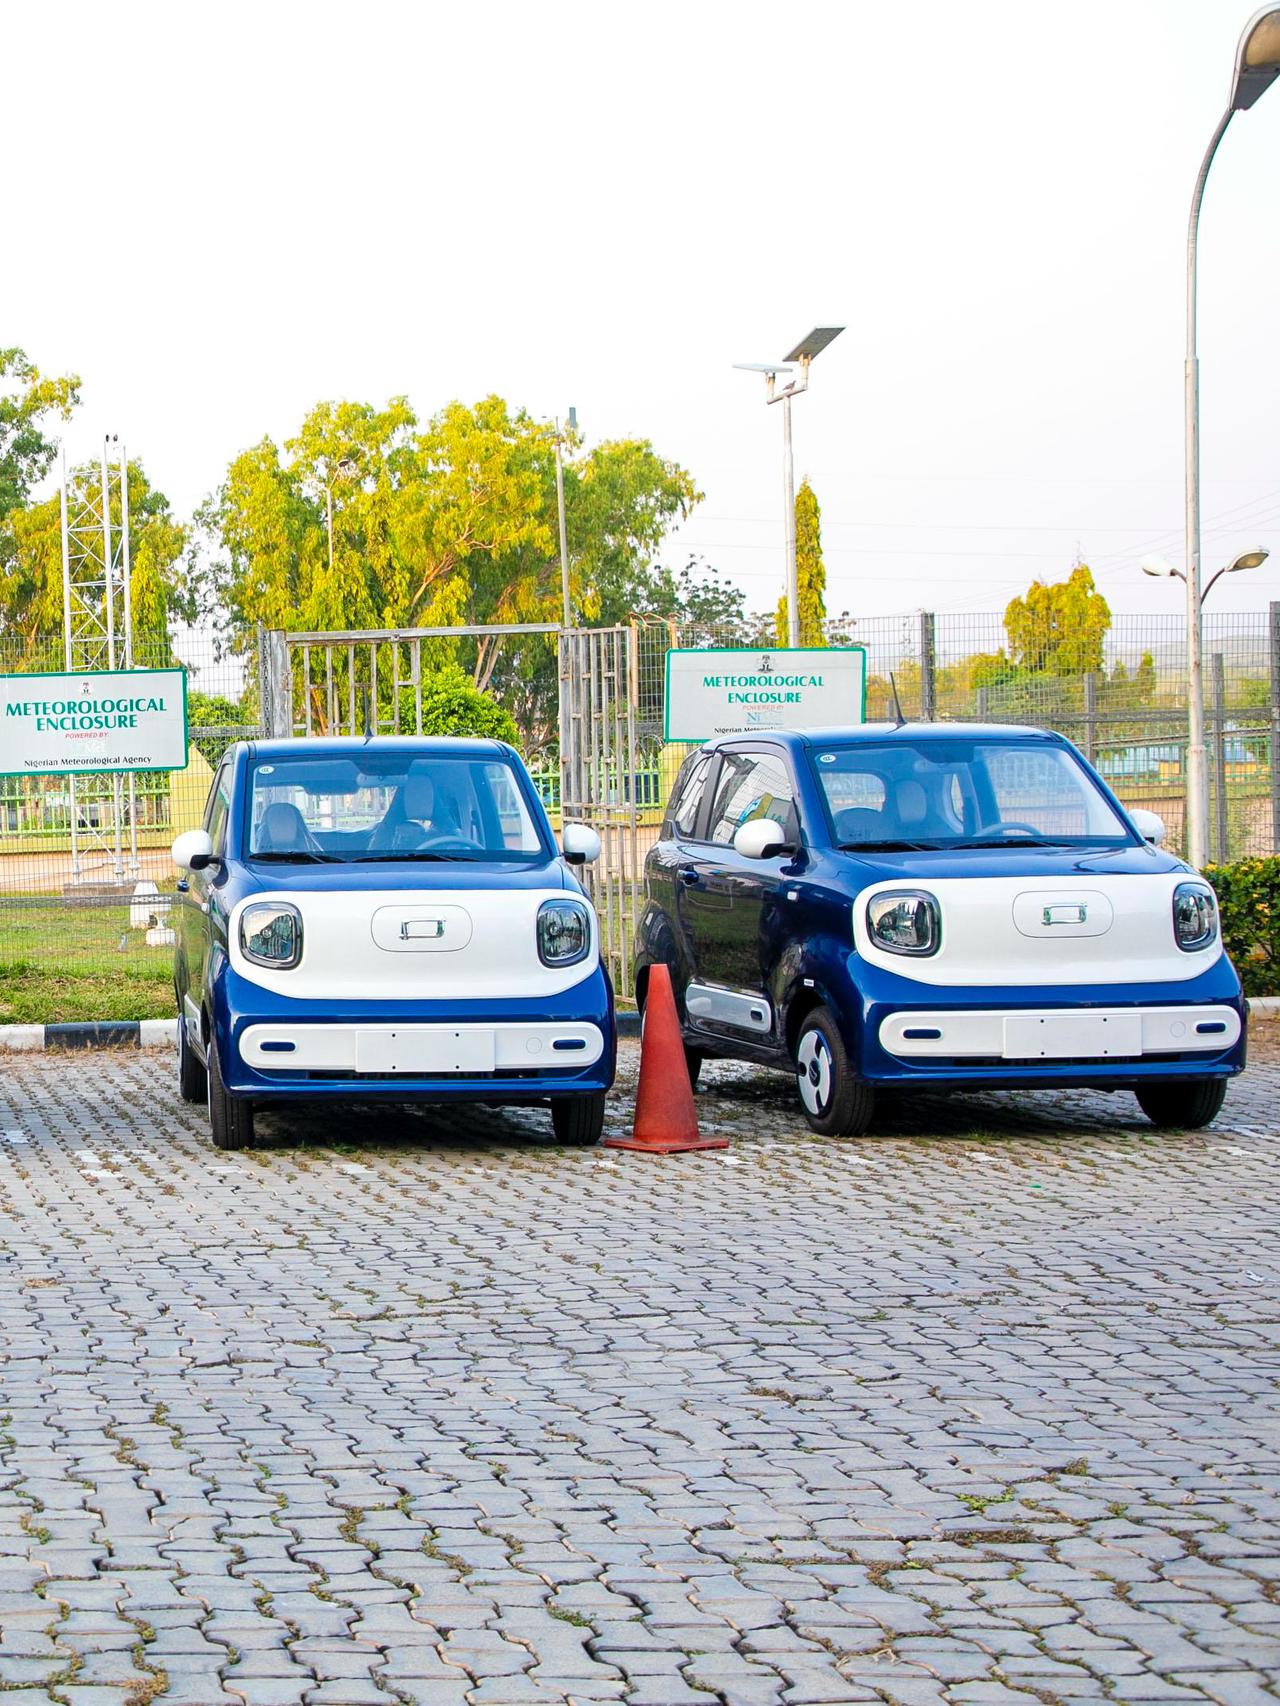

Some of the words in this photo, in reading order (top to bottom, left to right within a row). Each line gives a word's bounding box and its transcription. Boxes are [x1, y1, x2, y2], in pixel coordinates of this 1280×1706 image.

[703, 676, 824, 687] METEOROLOGICAL
[728, 692, 801, 703] ENCLOSURE
[6, 698, 167, 716] METEOROLOGICAL
[37, 715, 137, 731] ENCLOSURE
[24, 758, 58, 768] Nigerian
[61, 756, 120, 766] Meteorological
[123, 755, 152, 765] Agency
